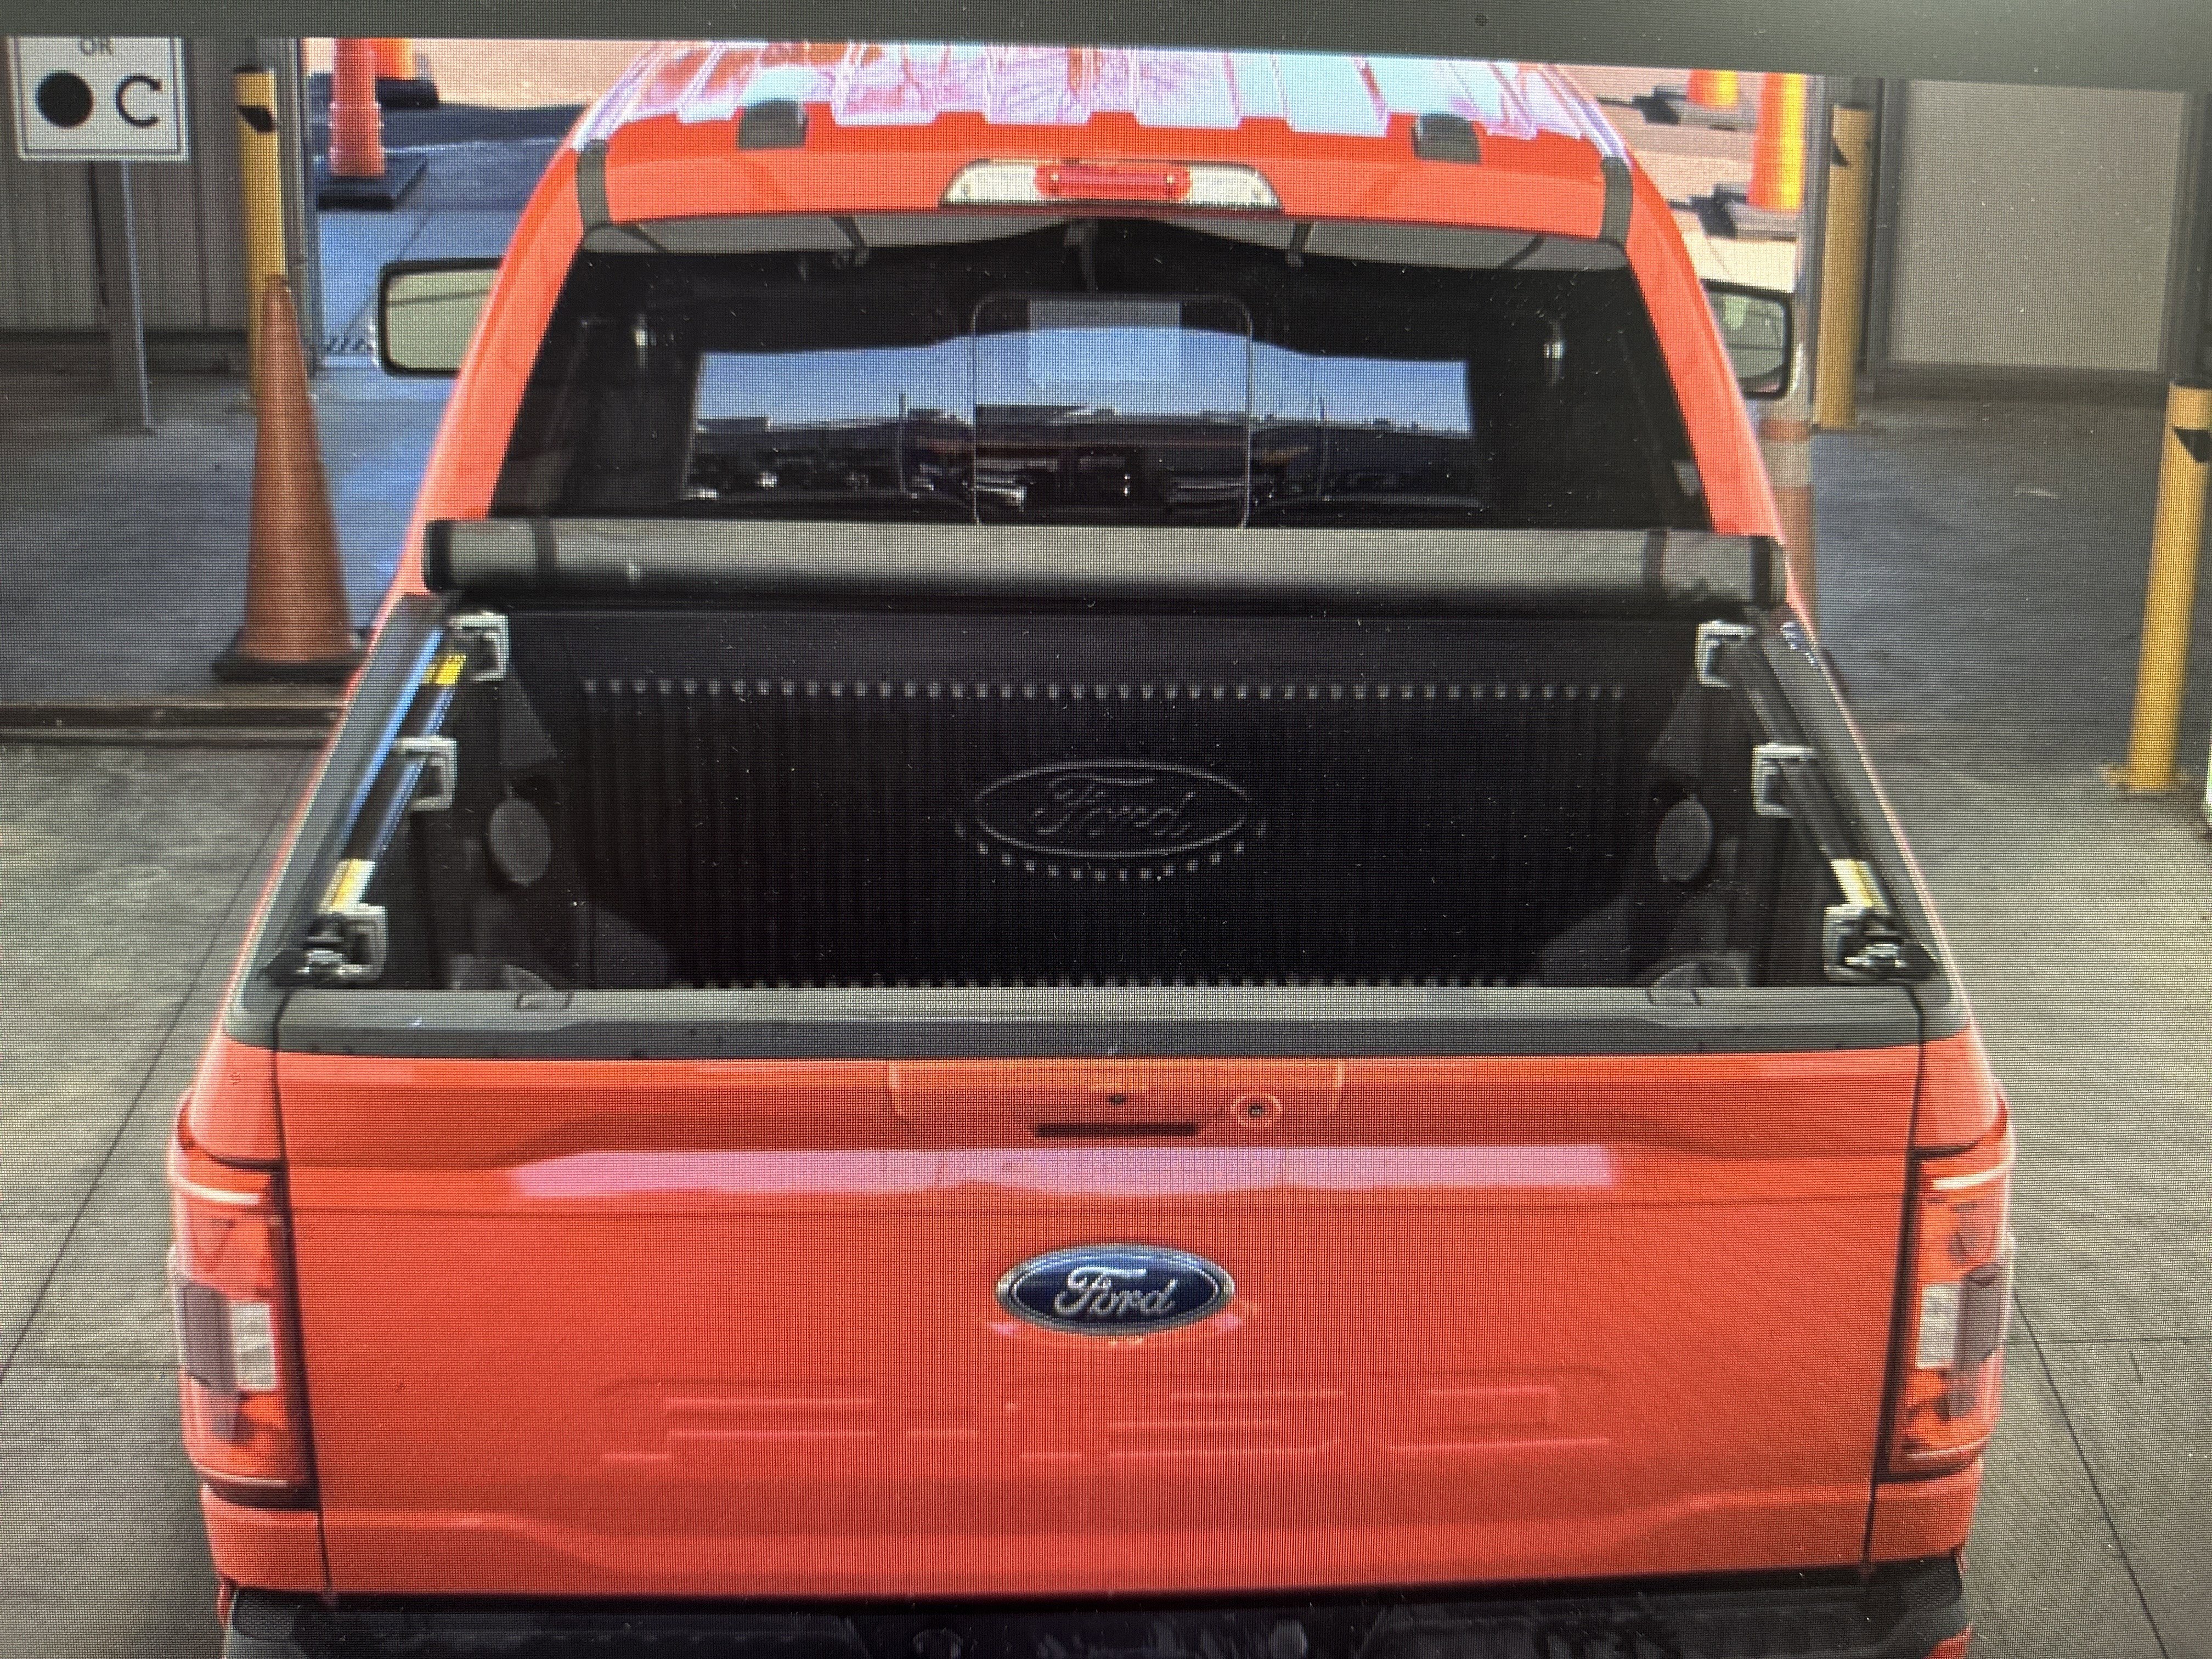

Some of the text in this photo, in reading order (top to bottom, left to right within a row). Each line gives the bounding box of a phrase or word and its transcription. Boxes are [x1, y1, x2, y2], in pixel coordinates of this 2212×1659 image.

[80, 37, 114, 55] OR
[116, 75, 161, 127] C
[1030, 772, 1198, 838] Ford
[1053, 1264, 1178, 1317] Ford
[597, 1366, 1616, 1464] F-150
